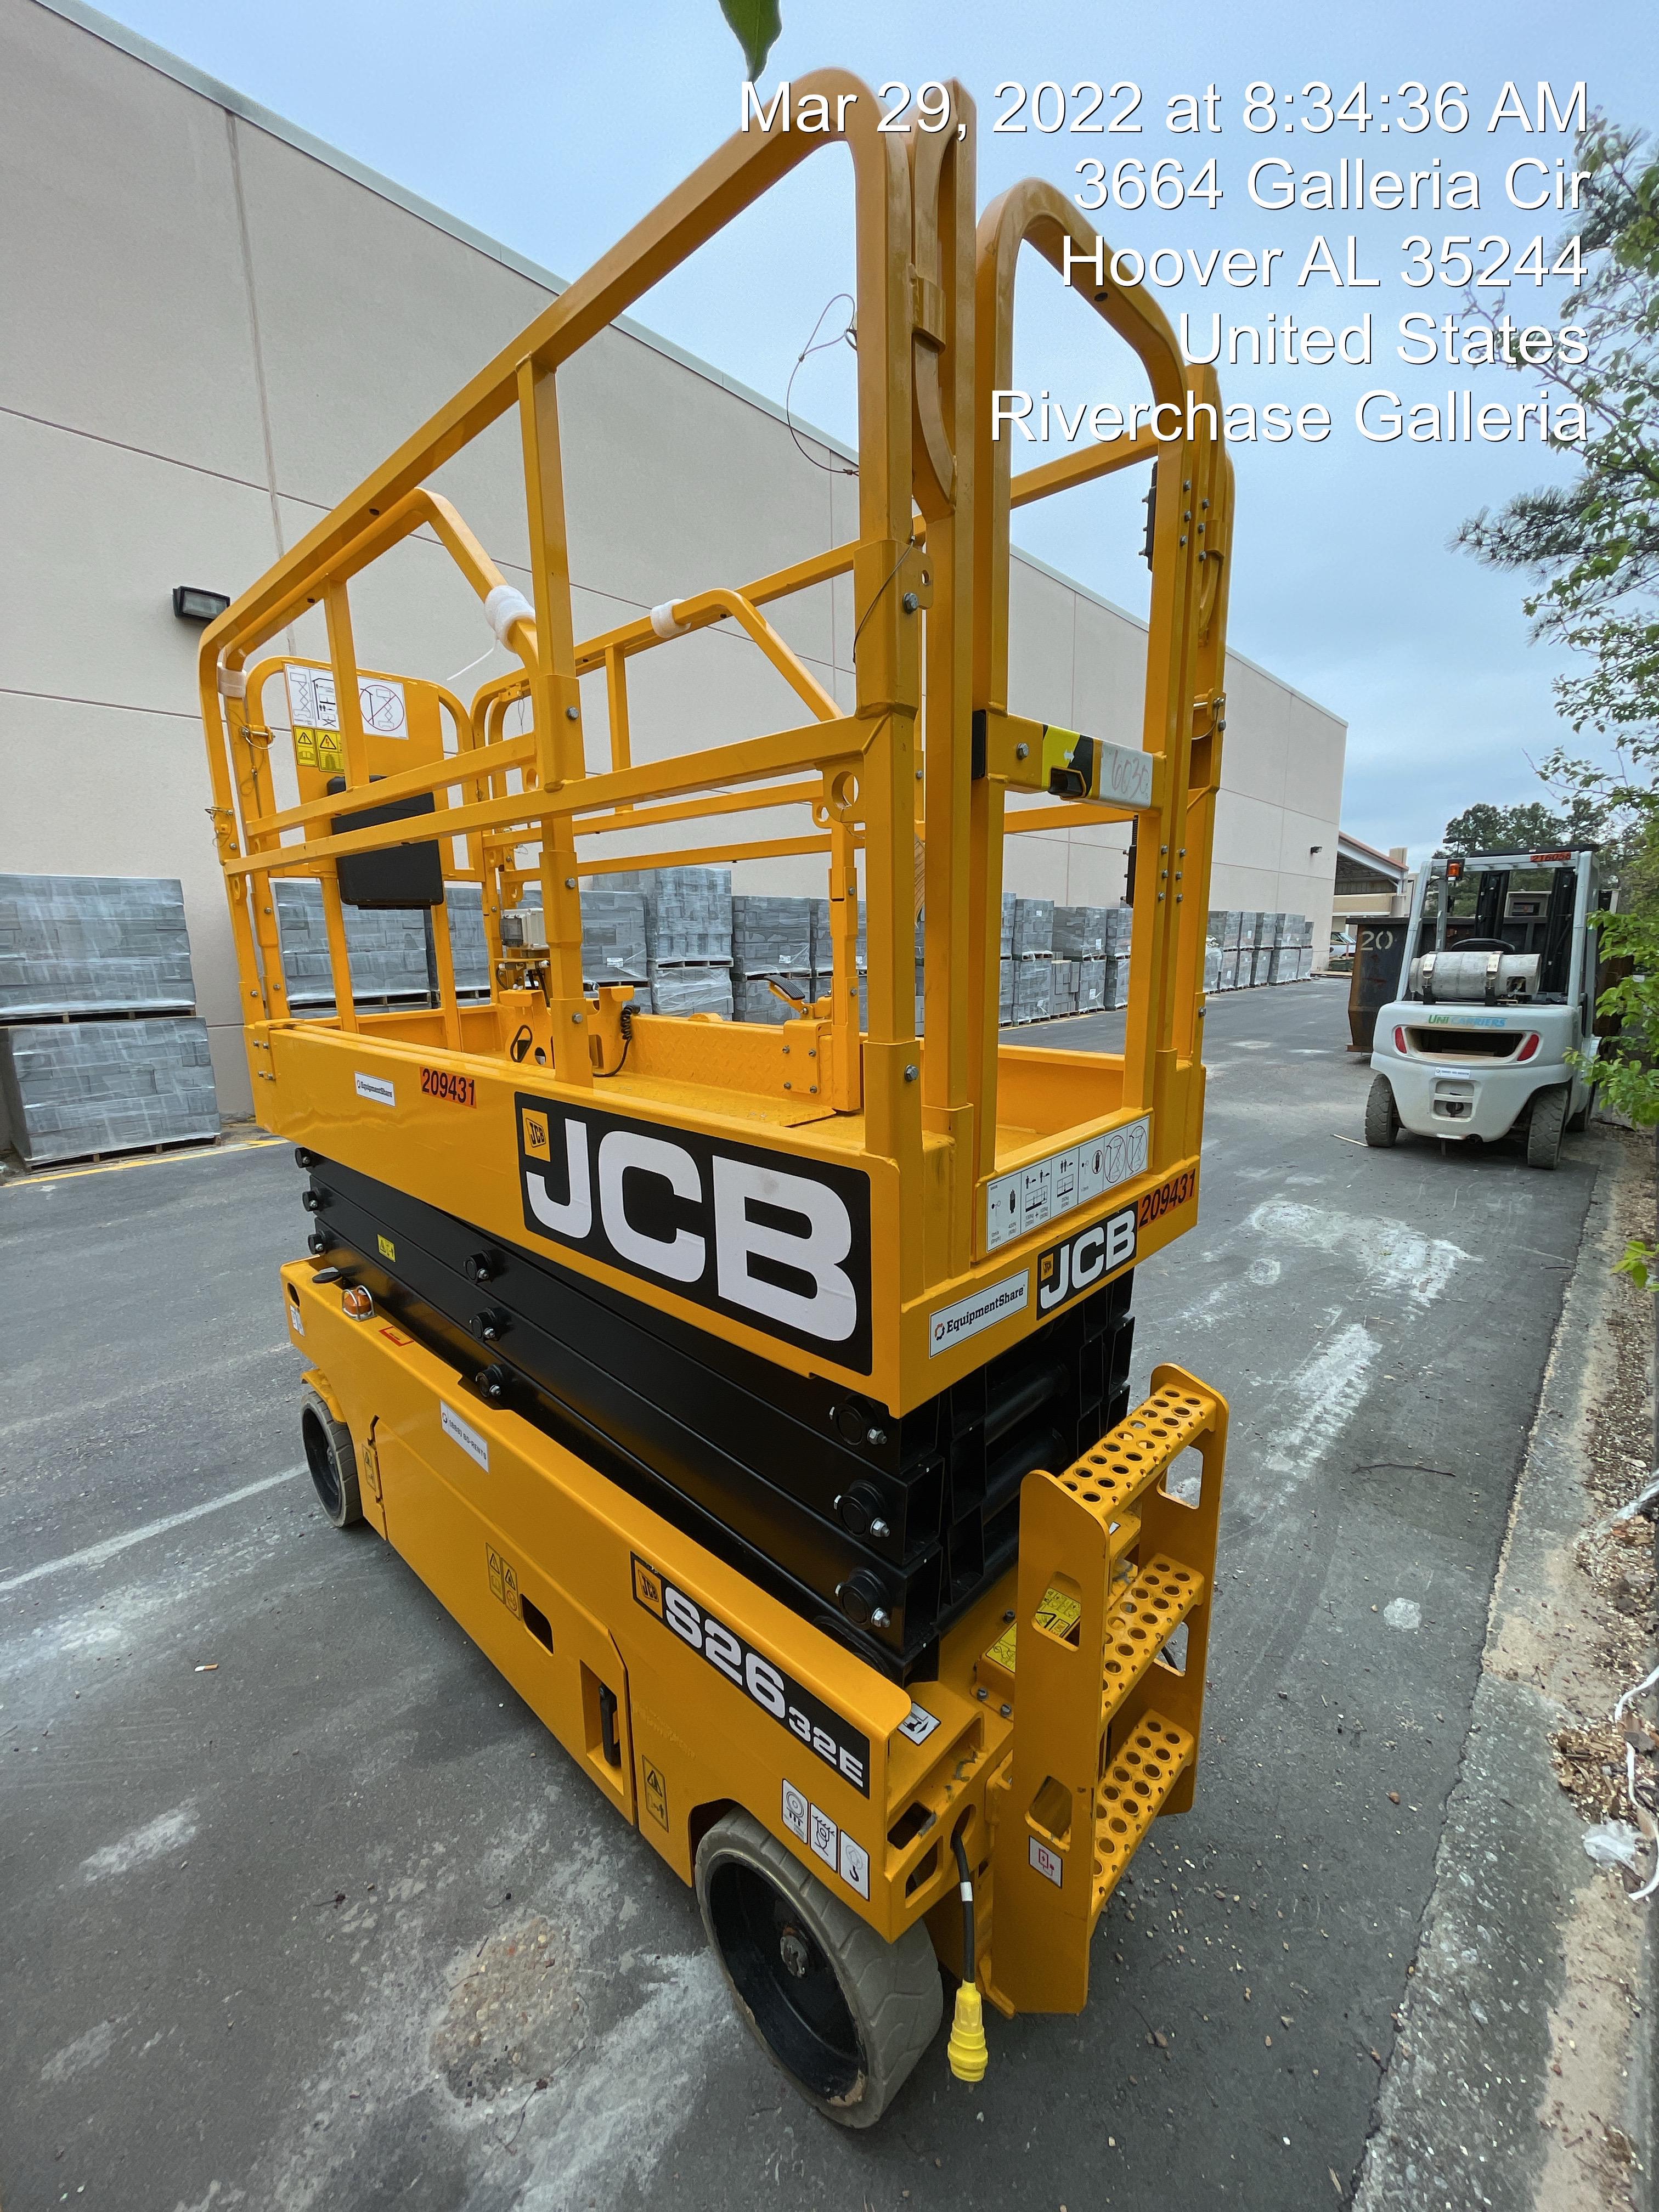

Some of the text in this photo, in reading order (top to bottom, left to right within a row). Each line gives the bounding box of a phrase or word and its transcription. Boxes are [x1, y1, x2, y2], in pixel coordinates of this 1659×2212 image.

[1361, 930, 1393, 951] 20
[422, 1068, 475, 1106] 209431
[529, 1121, 545, 1145] JCB
[1138, 1168, 1196, 1229] 209431
[526, 1118, 857, 1341] JCB
[1040, 1210, 1136, 1309] JCB
[946, 1286, 1024, 1334] EquipmentShare
[641, 1575, 658, 1600] JCB
